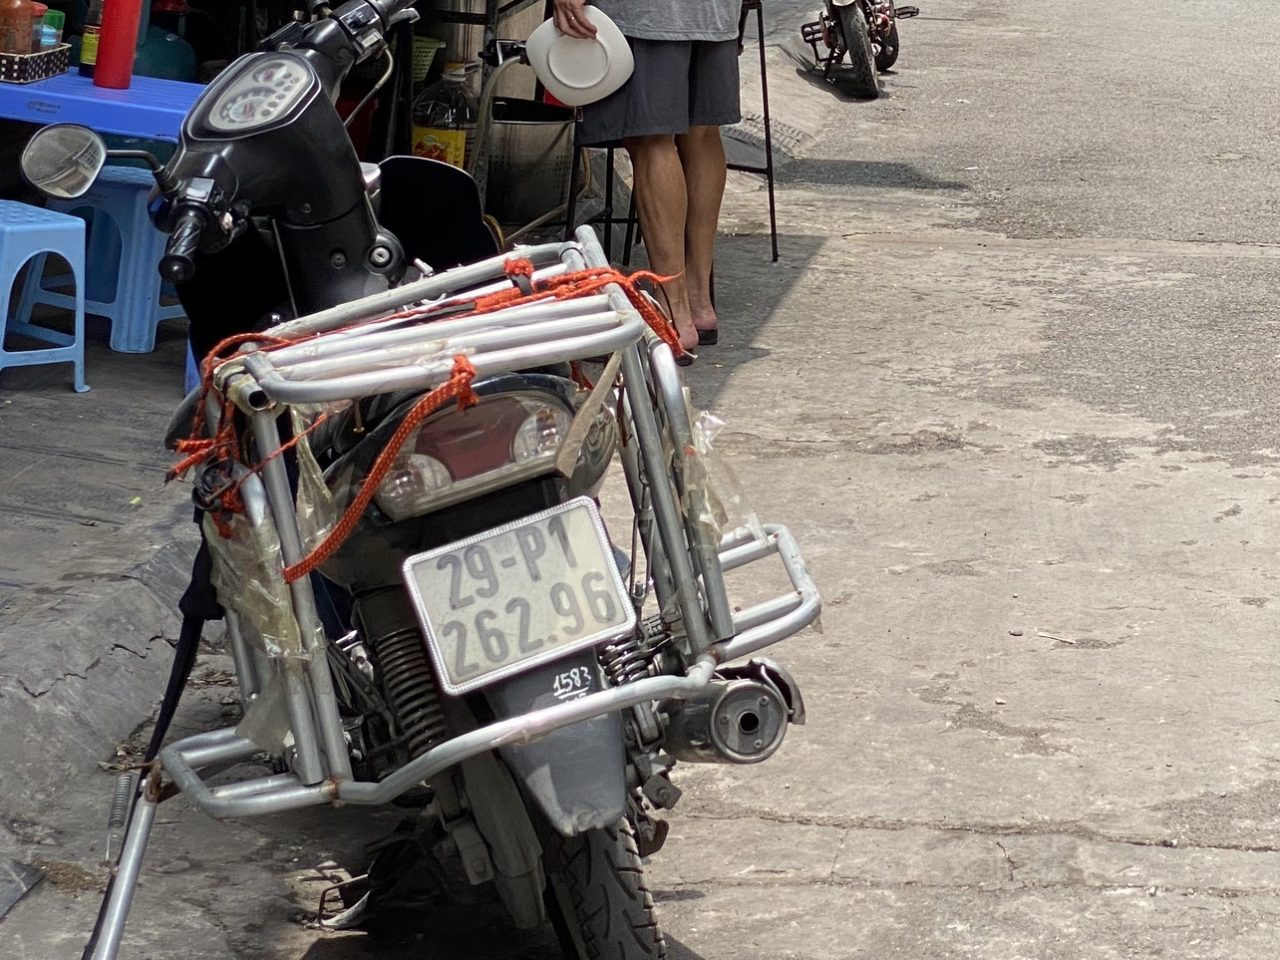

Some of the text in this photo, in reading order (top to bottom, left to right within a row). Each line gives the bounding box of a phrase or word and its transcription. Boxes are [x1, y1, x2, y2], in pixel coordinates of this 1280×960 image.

[437, 516, 577, 610] 29-P1
[442, 571, 616, 678] 262.96
[553, 666, 592, 696] 1583
